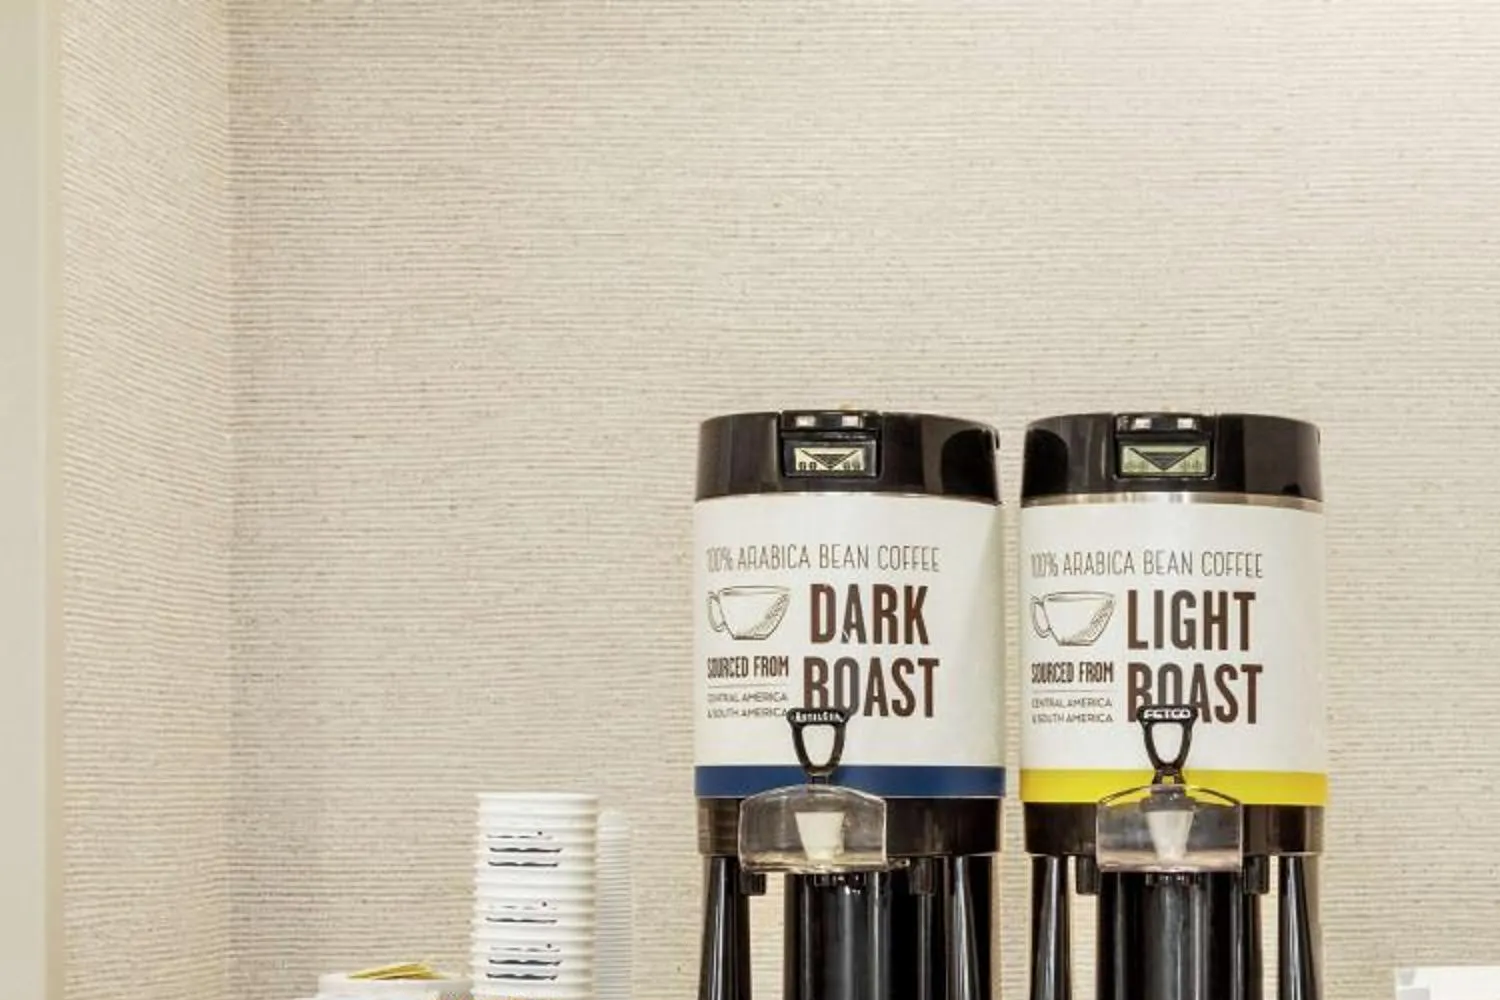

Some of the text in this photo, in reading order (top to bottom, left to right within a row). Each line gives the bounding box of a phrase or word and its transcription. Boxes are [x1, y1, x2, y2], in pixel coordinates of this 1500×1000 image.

[737, 543, 811, 570] ARABICA
[818, 543, 870, 569] BEAN
[877, 545, 941, 573] COFFEE
[1062, 549, 1136, 578] ARABICA
[1143, 549, 1194, 576] BEAN
[1200, 551, 1264, 579] COFFEE
[810, 583, 930, 645] DARK
[1127, 589, 1257, 651] LIGHT
[706, 655, 790, 679] SOURCED FROM
[803, 656, 940, 718] ROAST
[1031, 660, 1115, 684] SOURCED FROM
[1127, 661, 1264, 725] ROAST
